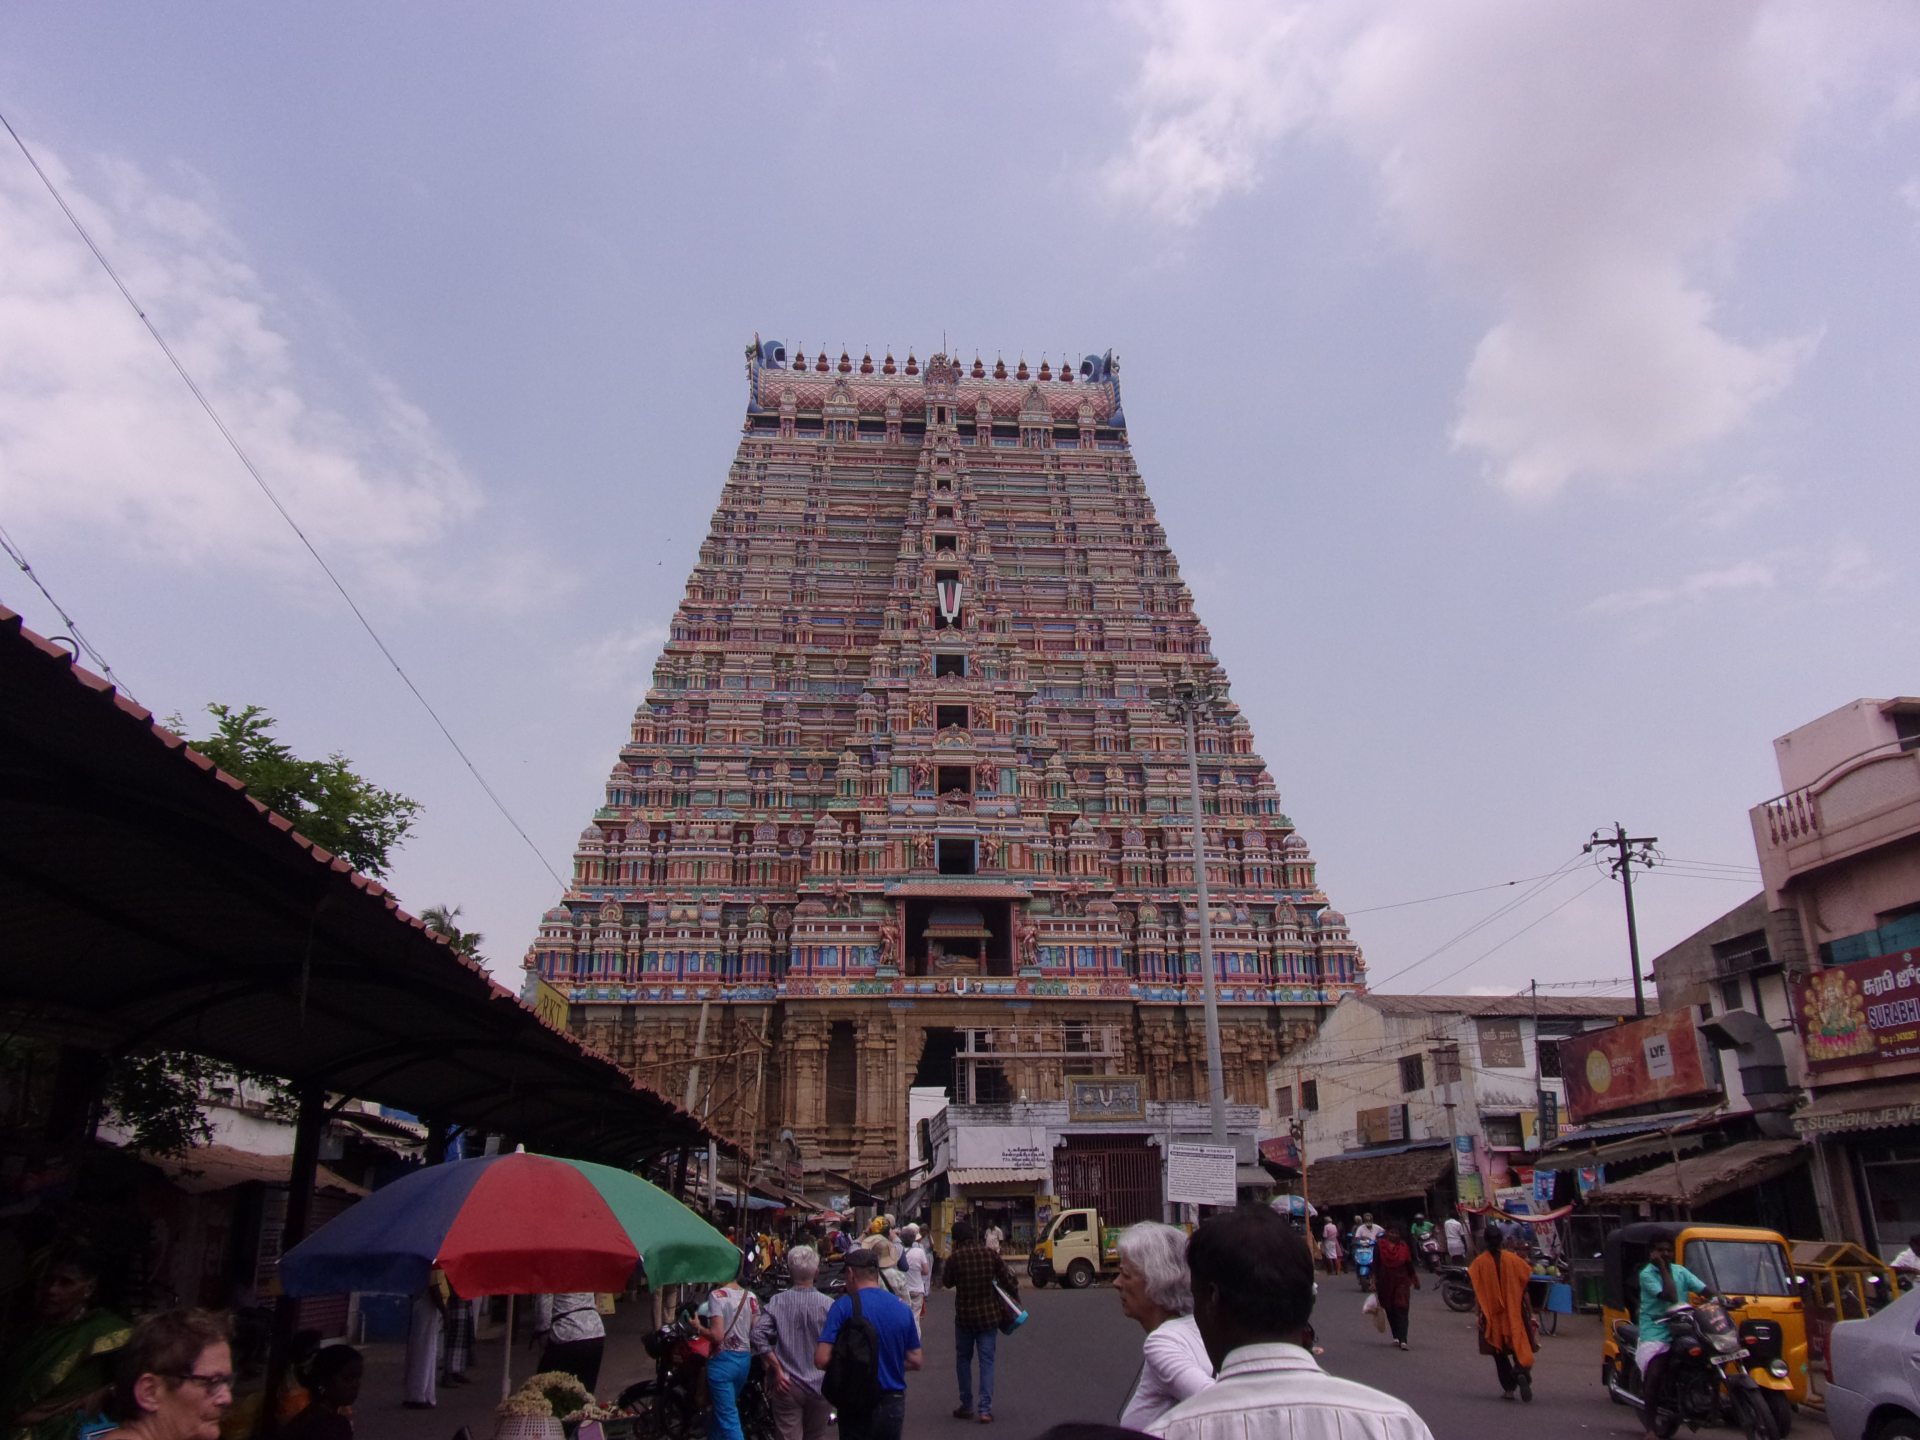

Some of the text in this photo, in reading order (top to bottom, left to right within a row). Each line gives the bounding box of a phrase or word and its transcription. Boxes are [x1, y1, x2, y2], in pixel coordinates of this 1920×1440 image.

[1863, 969, 1895, 996] சுரபி
[1868, 998, 1920, 1030] SURABHI
[1649, 1044, 1666, 1059] LYF
[1808, 1112, 1871, 1131] SURABHI
